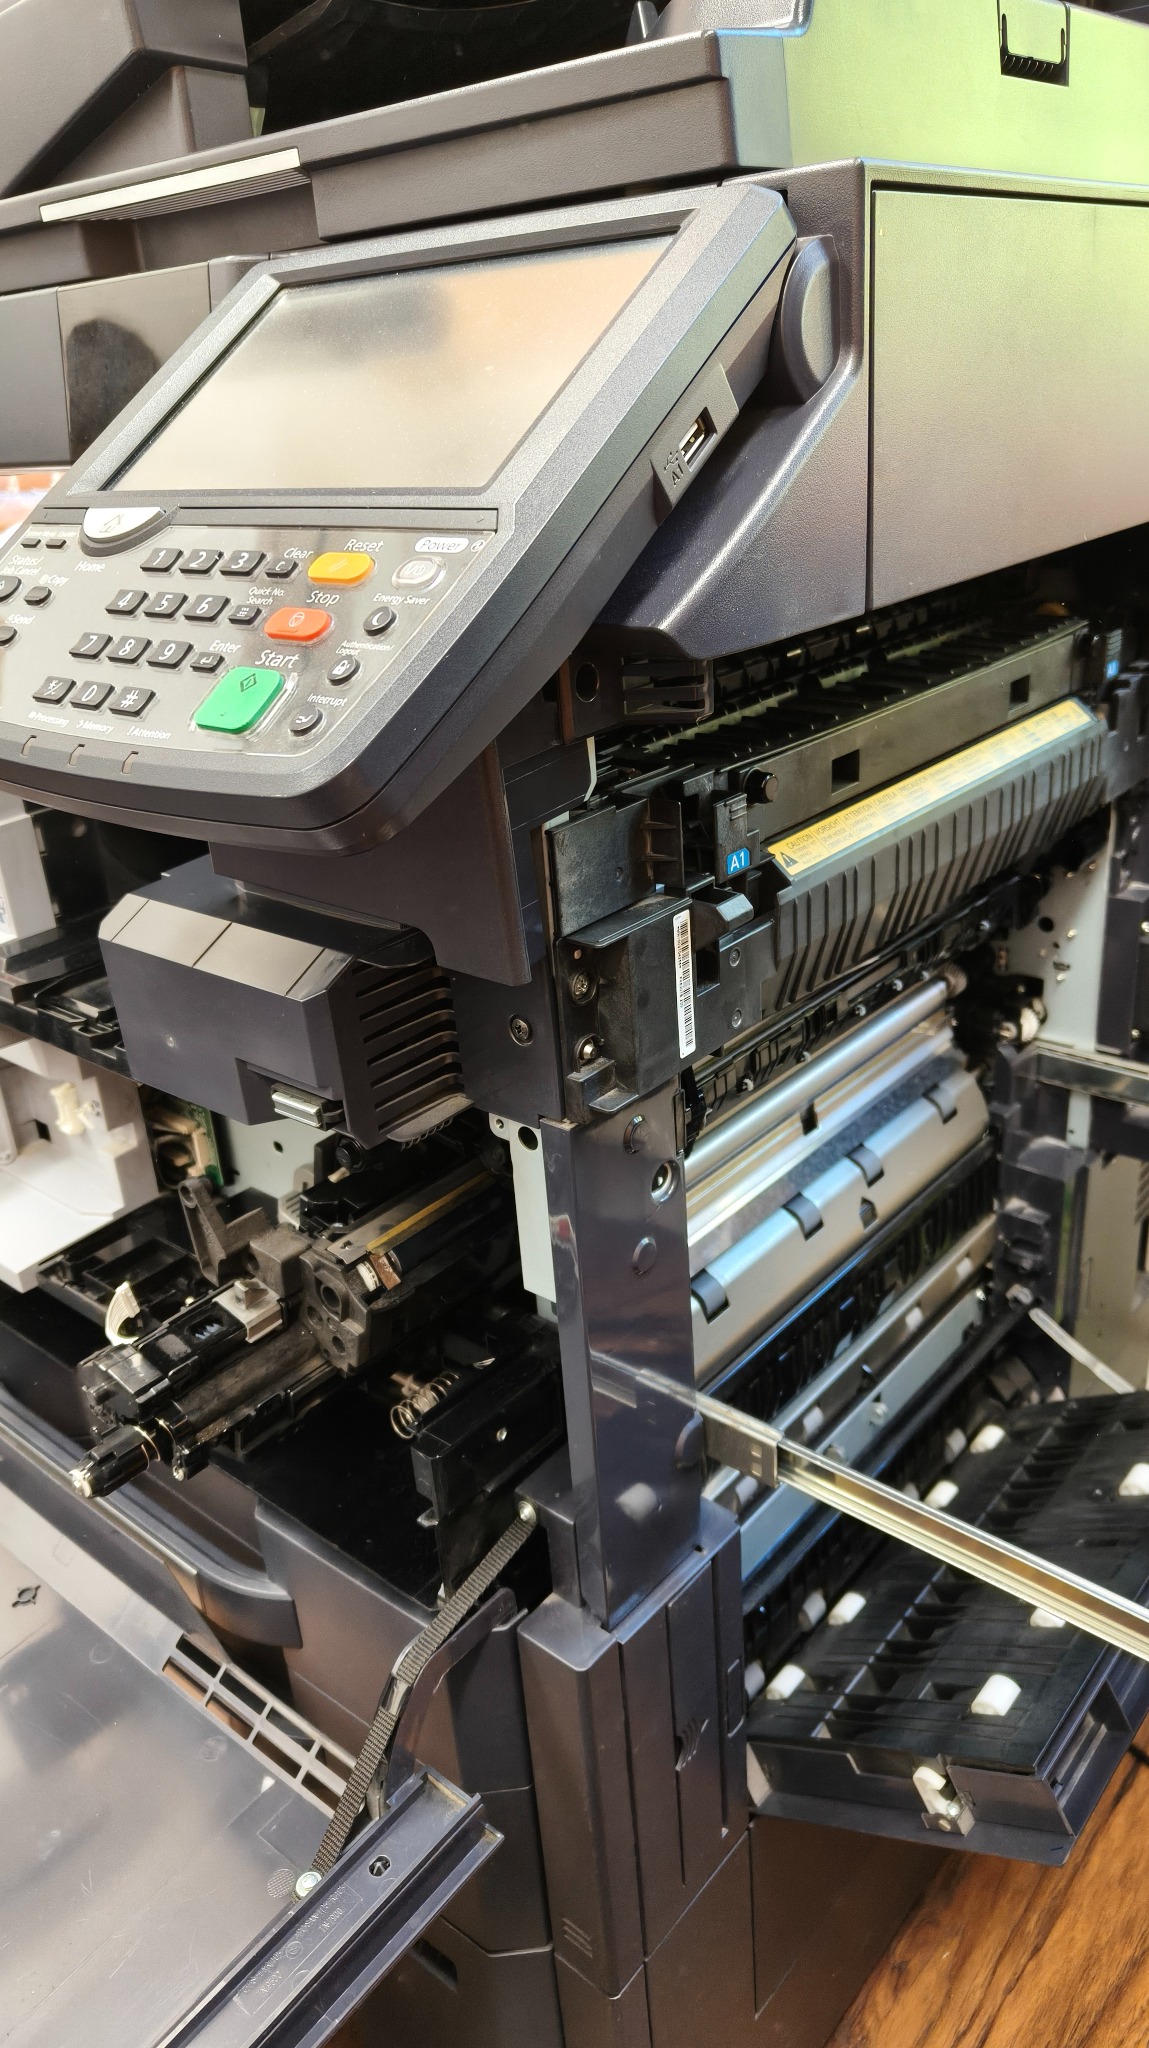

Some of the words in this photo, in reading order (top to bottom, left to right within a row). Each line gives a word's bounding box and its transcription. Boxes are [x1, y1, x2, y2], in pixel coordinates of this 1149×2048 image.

[344, 539, 384, 552] Reset
[421, 539, 461, 550] Power
[9, 555, 44, 566] Status/
[153, 551, 165, 565] 1
[190, 552, 206, 567] 2
[231, 552, 248, 568] 3
[284, 548, 314, 560] Clear
[74, 561, 106, 572] Home
[48, 575, 70, 587] Copy
[249, 586, 270, 596] Quick
[270, 588, 284, 597] No.
[306, 591, 340, 606] Stop
[373, 592, 403, 605] Energy
[404, 595, 430, 605] Saver
[117, 592, 134, 608] 4
[155, 594, 174, 611] 5
[196, 597, 209, 614] 6
[247, 595, 273, 605] Search
[12, 615, 36, 625] Send
[80, 636, 97, 651] 7
[118, 639, 135, 655] 8
[209, 640, 241, 653] Enter
[158, 643, 176, 660] 9
[255, 651, 299, 668] Start
[81, 685, 97, 701] 0
[121, 690, 139, 708] #
[308, 693, 347, 707] Interrupt
[34, 712, 69, 726] Processing
[83, 721, 114, 734] Memory
[133, 729, 172, 740] Attention
[843, 804, 873, 822] ATTENTION
[815, 819, 840, 836] VORSICHT
[786, 833, 813, 849] CAUTION
[730, 851, 745, 872] A1
